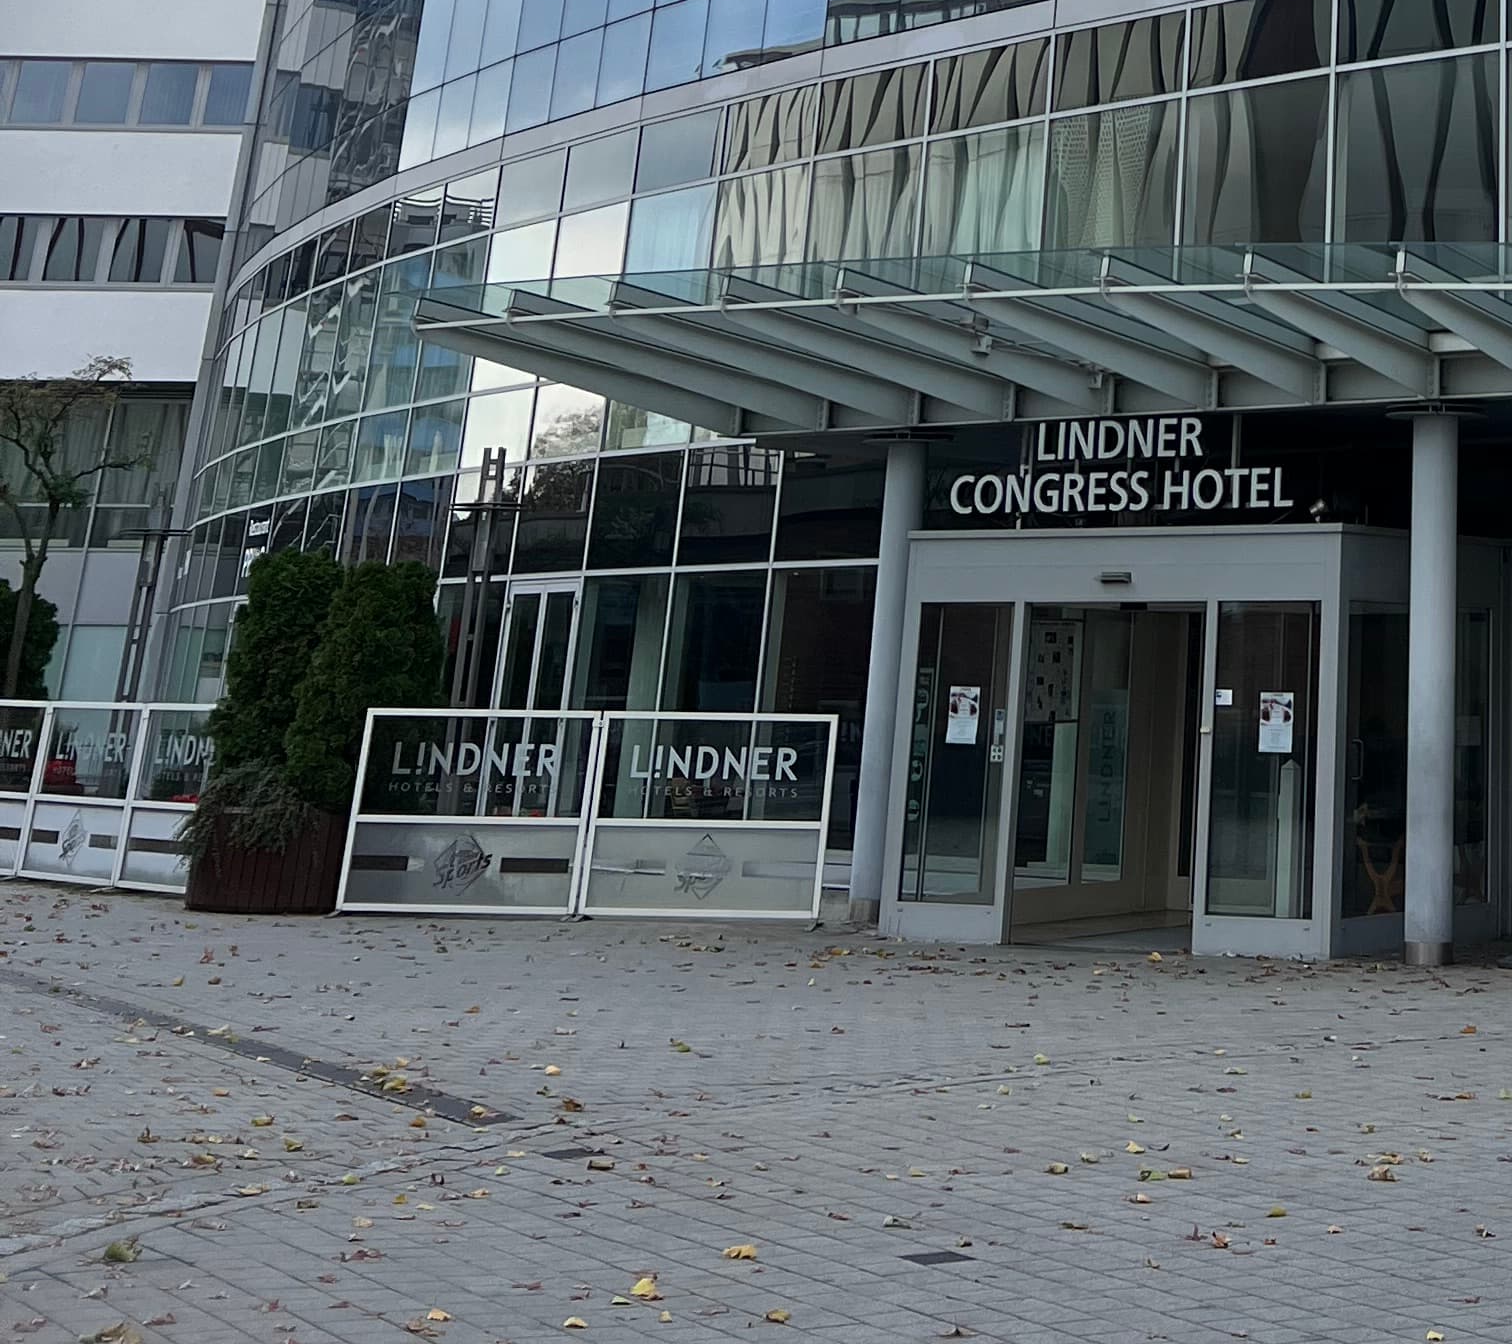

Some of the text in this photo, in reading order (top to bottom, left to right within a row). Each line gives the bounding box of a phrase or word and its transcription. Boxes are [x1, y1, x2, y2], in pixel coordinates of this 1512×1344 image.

[1037, 417, 1203, 461] LINDNER
[950, 466, 1293, 514] CONGRESS HOTEL
[388, 782, 453, 793] HOTELS
[486, 783, 557, 794] RESRT
